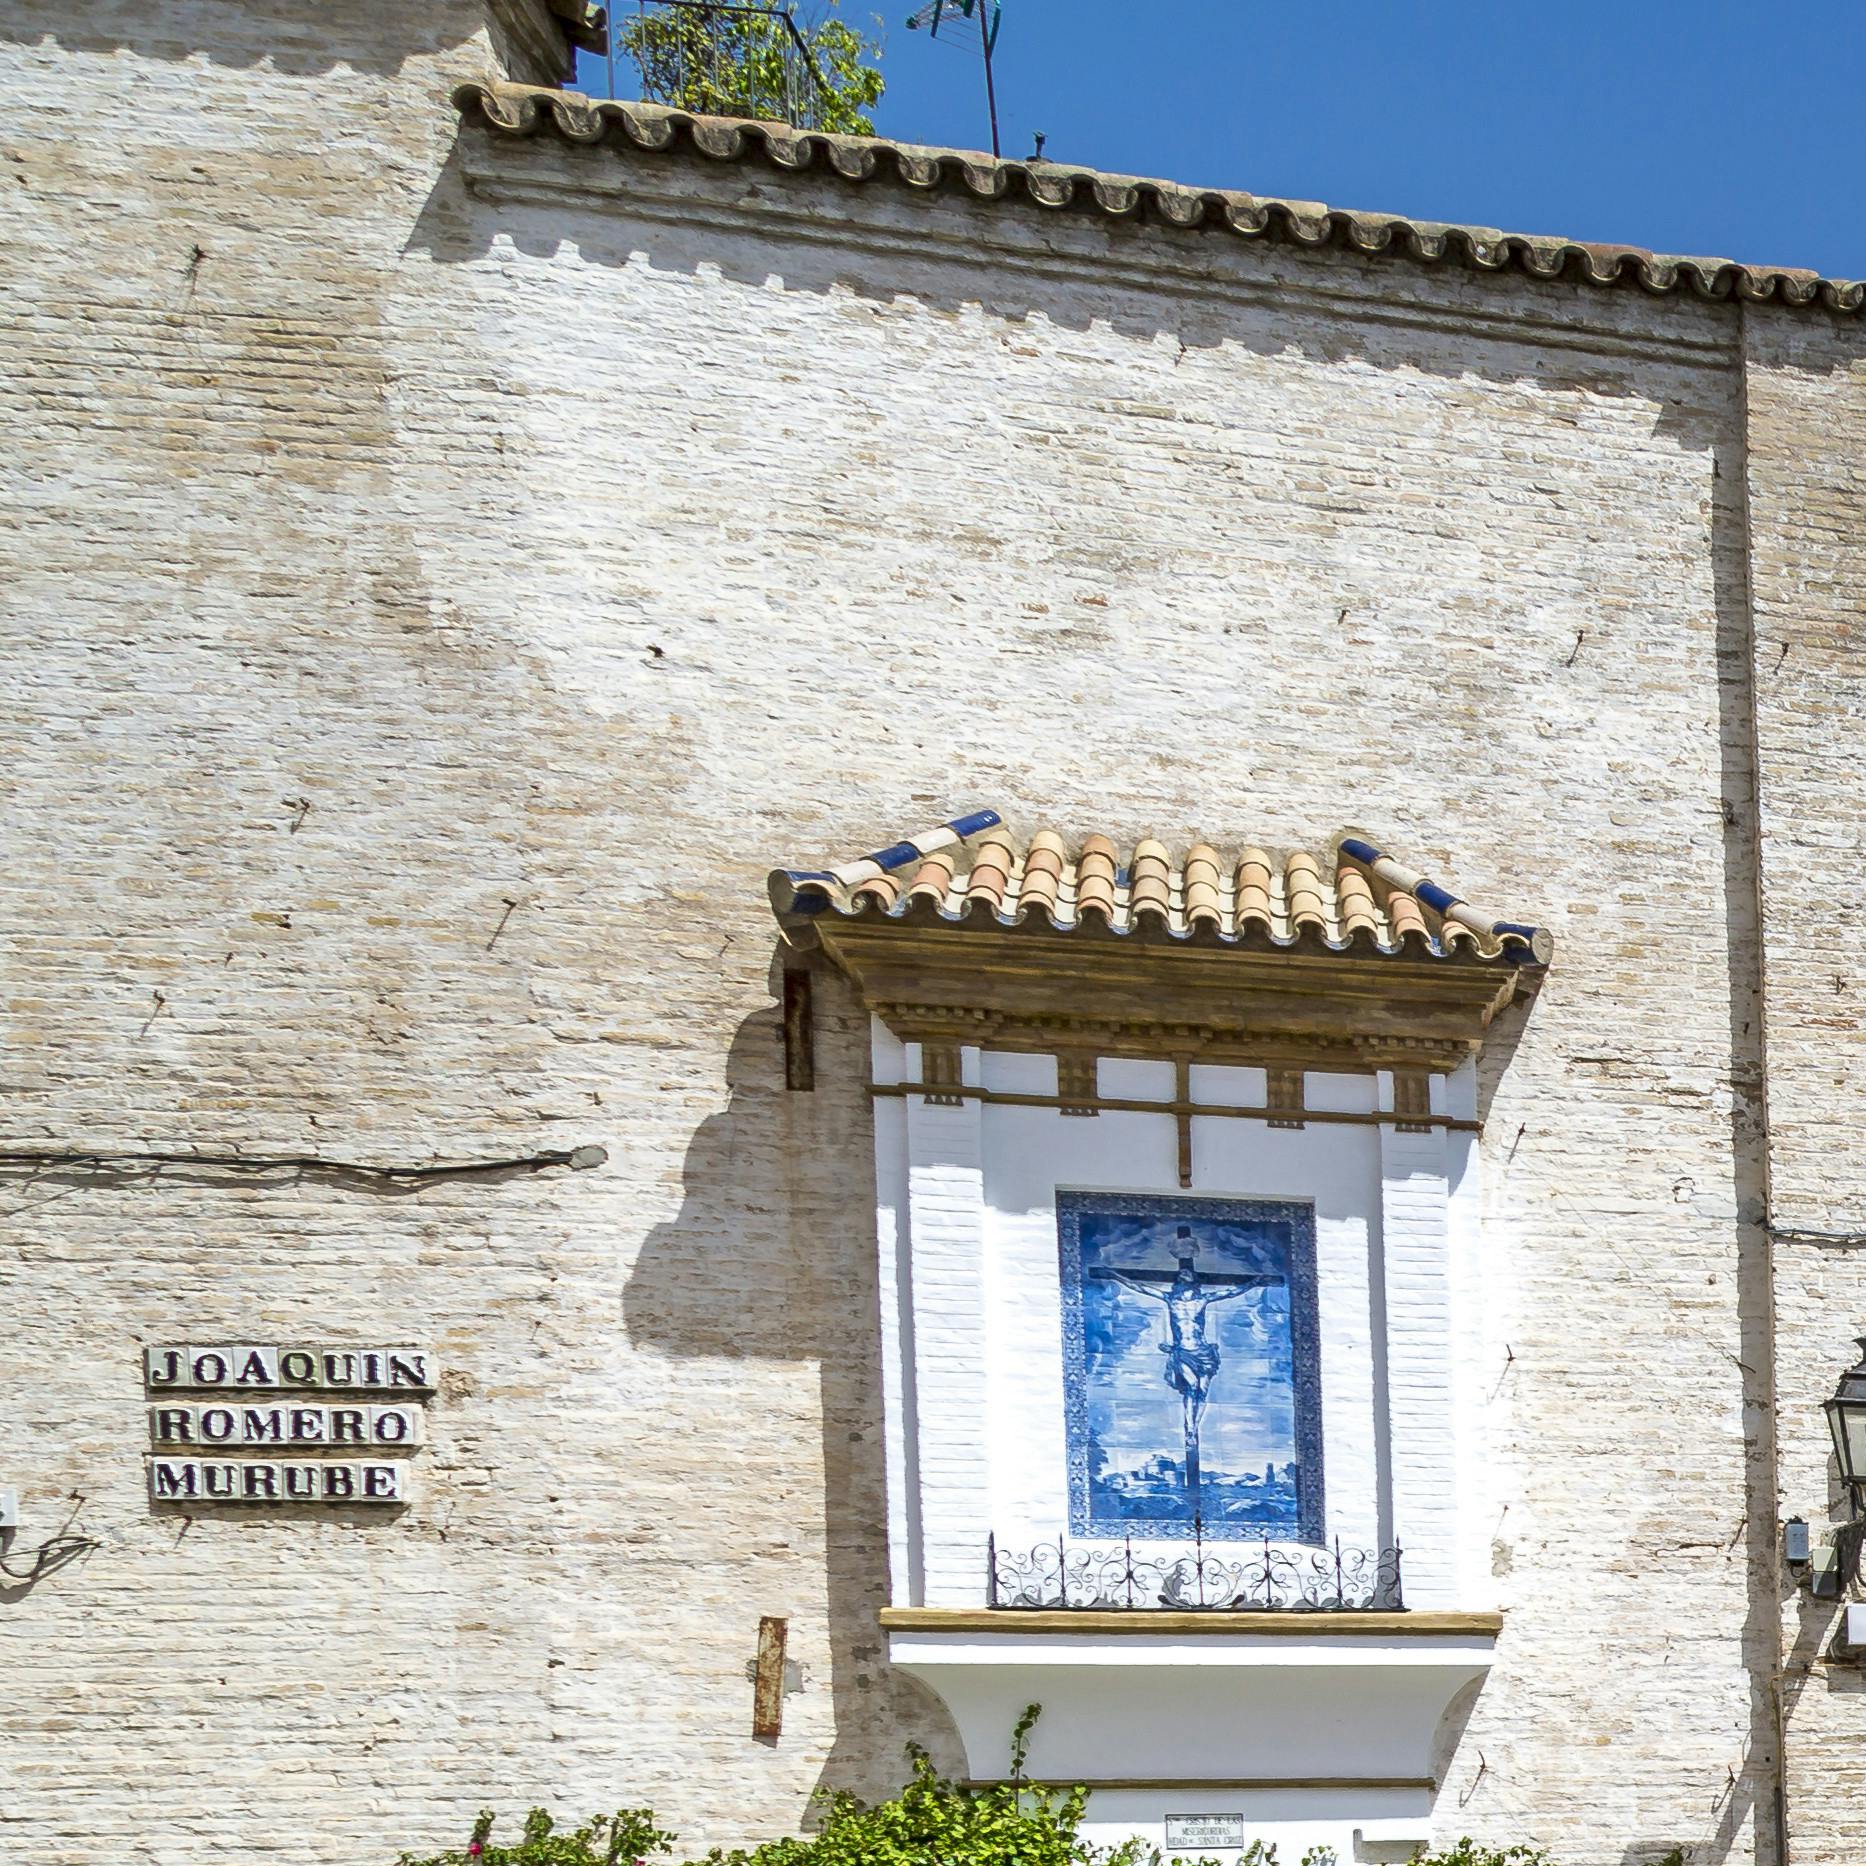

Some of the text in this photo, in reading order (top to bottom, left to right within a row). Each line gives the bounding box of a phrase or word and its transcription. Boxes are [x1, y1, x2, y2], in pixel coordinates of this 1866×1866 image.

[153, 1350, 426, 1387] JOAQUIN
[158, 1408, 408, 1442] ROMERO
[157, 1462, 396, 1499] MURUBE
